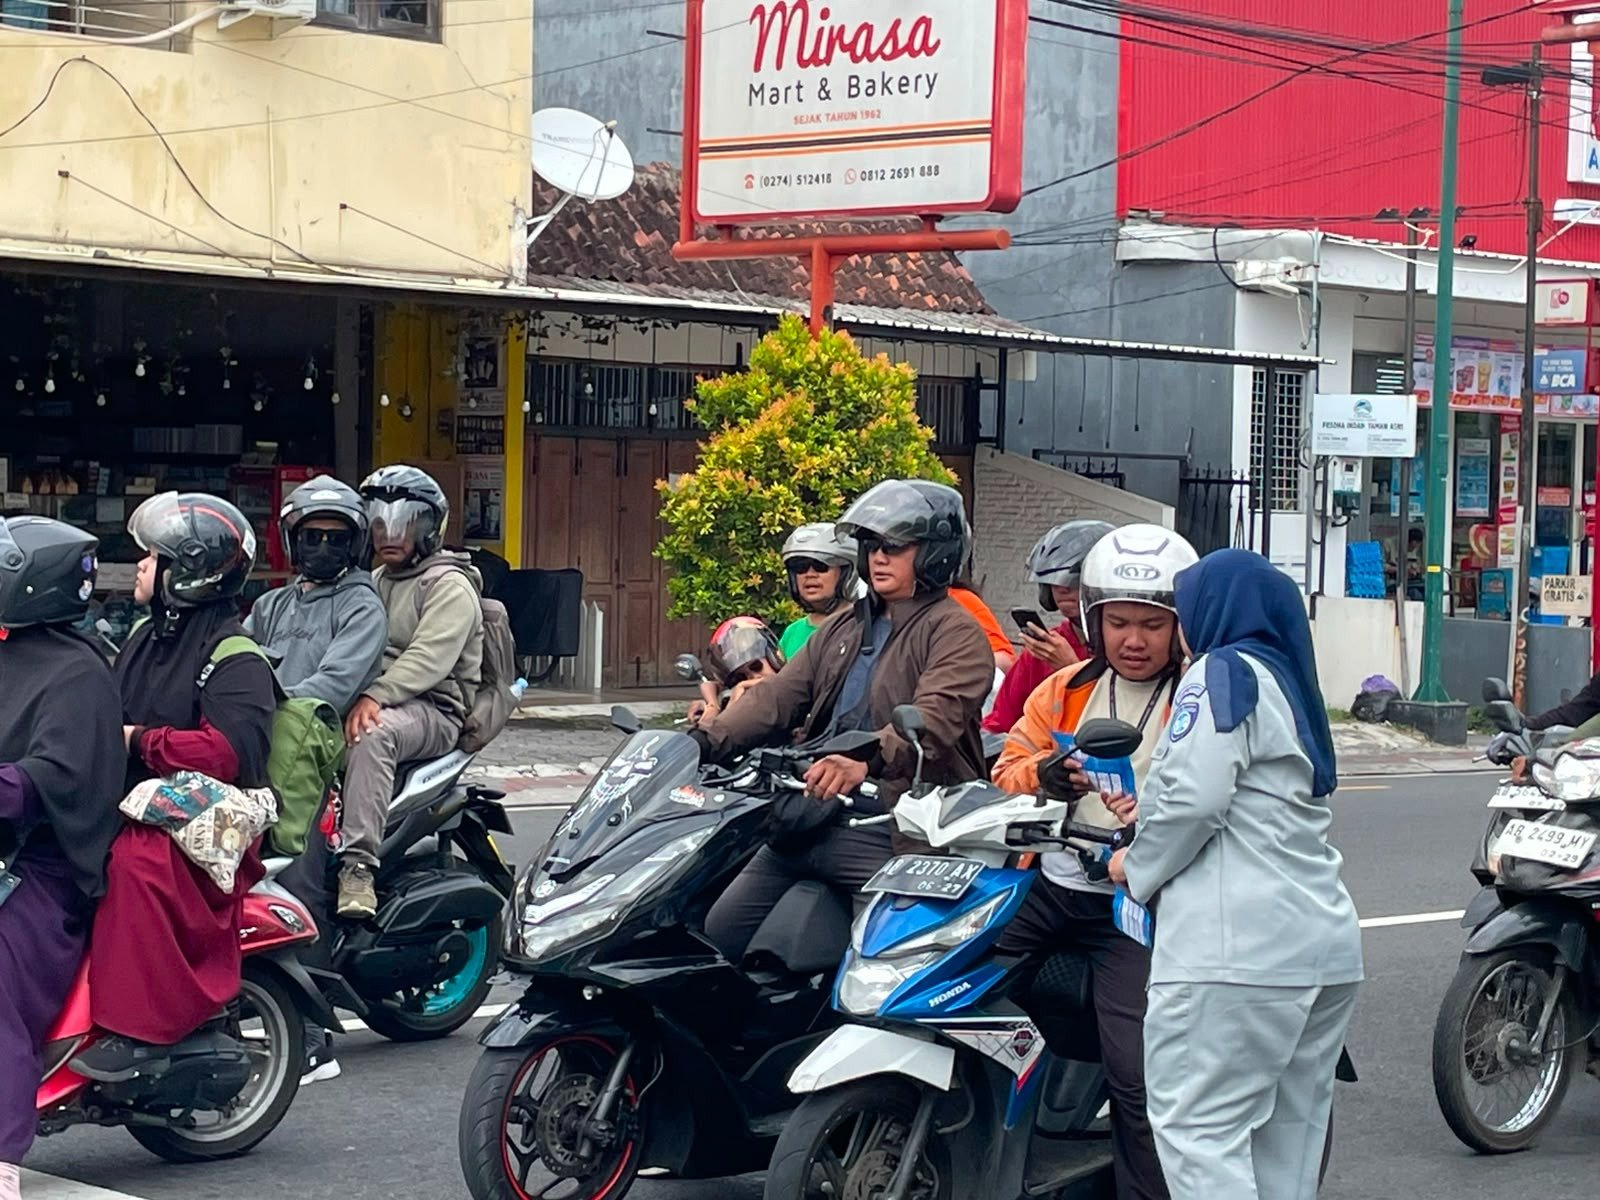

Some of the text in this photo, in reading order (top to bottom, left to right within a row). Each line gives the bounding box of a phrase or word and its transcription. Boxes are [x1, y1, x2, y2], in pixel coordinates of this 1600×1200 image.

[750, 0, 941, 73] Mirasa
[749, 71, 938, 107] Mart & Bakery
[794, 109, 881, 125] SEJAK TAHUN 1962
[760, 173, 832, 188] (0274) 512418
[860, 165, 940, 182] 0812 2691 888
[1551, 374, 1576, 387] BCA
[1544, 577, 1576, 590] PARKIR
[1544, 590, 1575, 602] GRATIS
[1505, 823, 1590, 849] AB 2499 MY
[906, 860, 949, 876] 2370
[949, 862, 979, 880] AX
[928, 981, 971, 1008] HONDA
